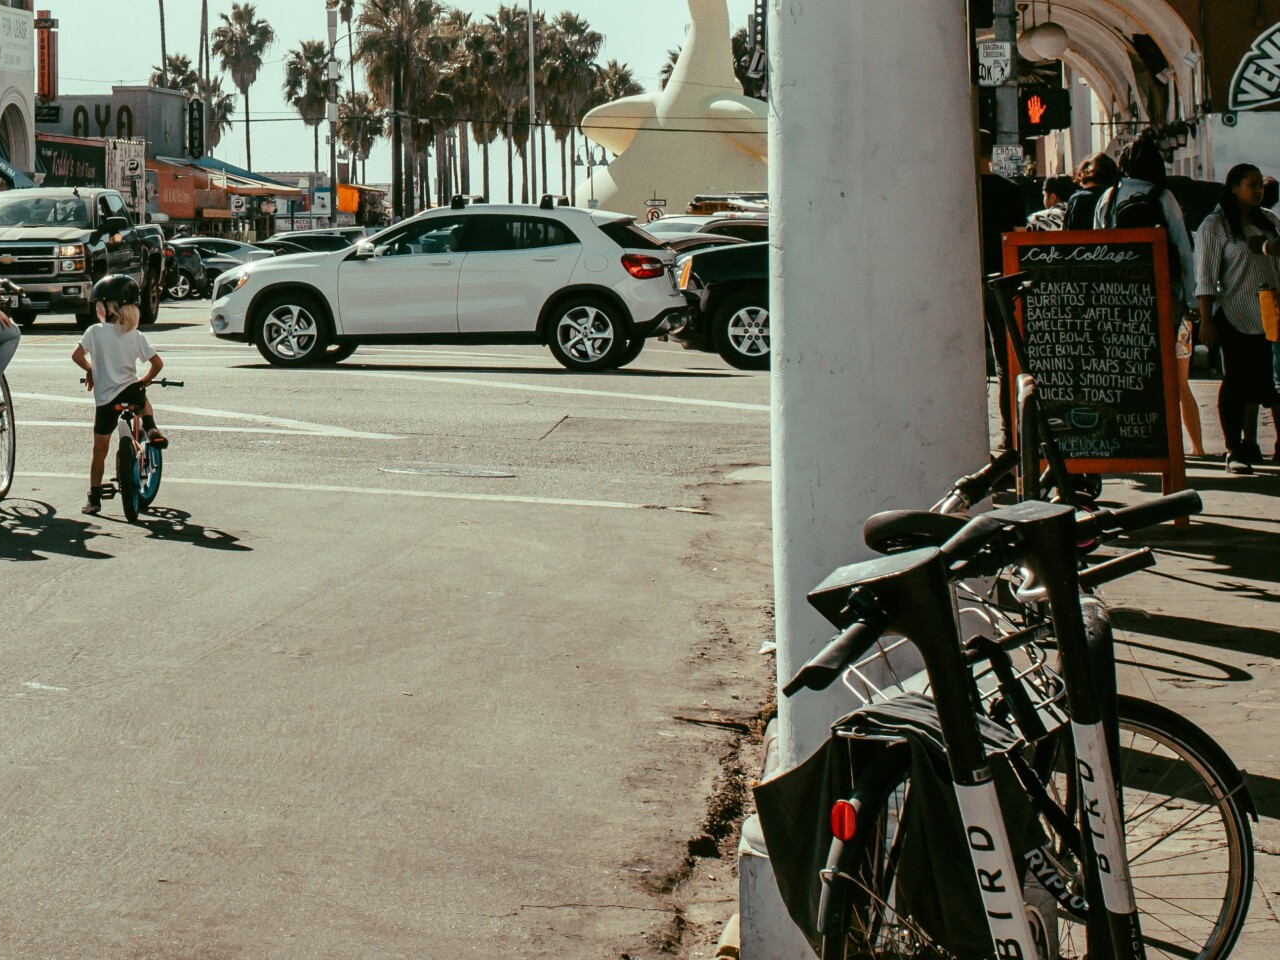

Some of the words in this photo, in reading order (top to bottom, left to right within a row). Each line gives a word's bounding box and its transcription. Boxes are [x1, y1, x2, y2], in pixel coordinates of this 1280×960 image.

[983, 43, 1005, 51] DIAGONAL
[980, 63, 993, 81] OK
[1237, 30, 1280, 103] VEN
[73, 104, 133, 141] AYA
[996, 147, 1018, 156] CROSS
[1021, 246, 1064, 263] Cafe
[1065, 245, 1140, 263] Collage
[1034, 282, 1088, 294] EAKFAST
[1091, 283, 1150, 297] SANDWICH
[1026, 295, 1085, 308] BURRITOS
[1092, 295, 1156, 307] CROISSANT
[1026, 306, 1072, 321] BAGELS
[1081, 307, 1122, 321] WAFFLE
[1128, 309, 1152, 323] LOX
[1027, 319, 1092, 332] OMELETTE
[1097, 321, 1155, 336] OATMEAL
[1028, 332, 1056, 345] ACAI
[1059, 331, 1094, 344] BOWL
[1102, 334, 1157, 348] GRANOLA
[1028, 344, 1053, 359] RICE
[1055, 344, 1096, 357] BOWLS
[1103, 346, 1150, 361] YOGURT
[1029, 358, 1074, 371] PANINIS
[1081, 359, 1120, 373] WRAPS
[1124, 360, 1156, 378] SOUP
[1033, 372, 1073, 386] ALADS
[1079, 373, 1144, 391] SMOOTHIES
[1037, 387, 1074, 401] UICES
[1081, 387, 1123, 404] TOAST
[1116, 413, 1141, 426] FUEL
[1144, 411, 1158, 426] UP
[1078, 438, 1121, 452] LOCALS
[967, 825, 1025, 960] BIRD
